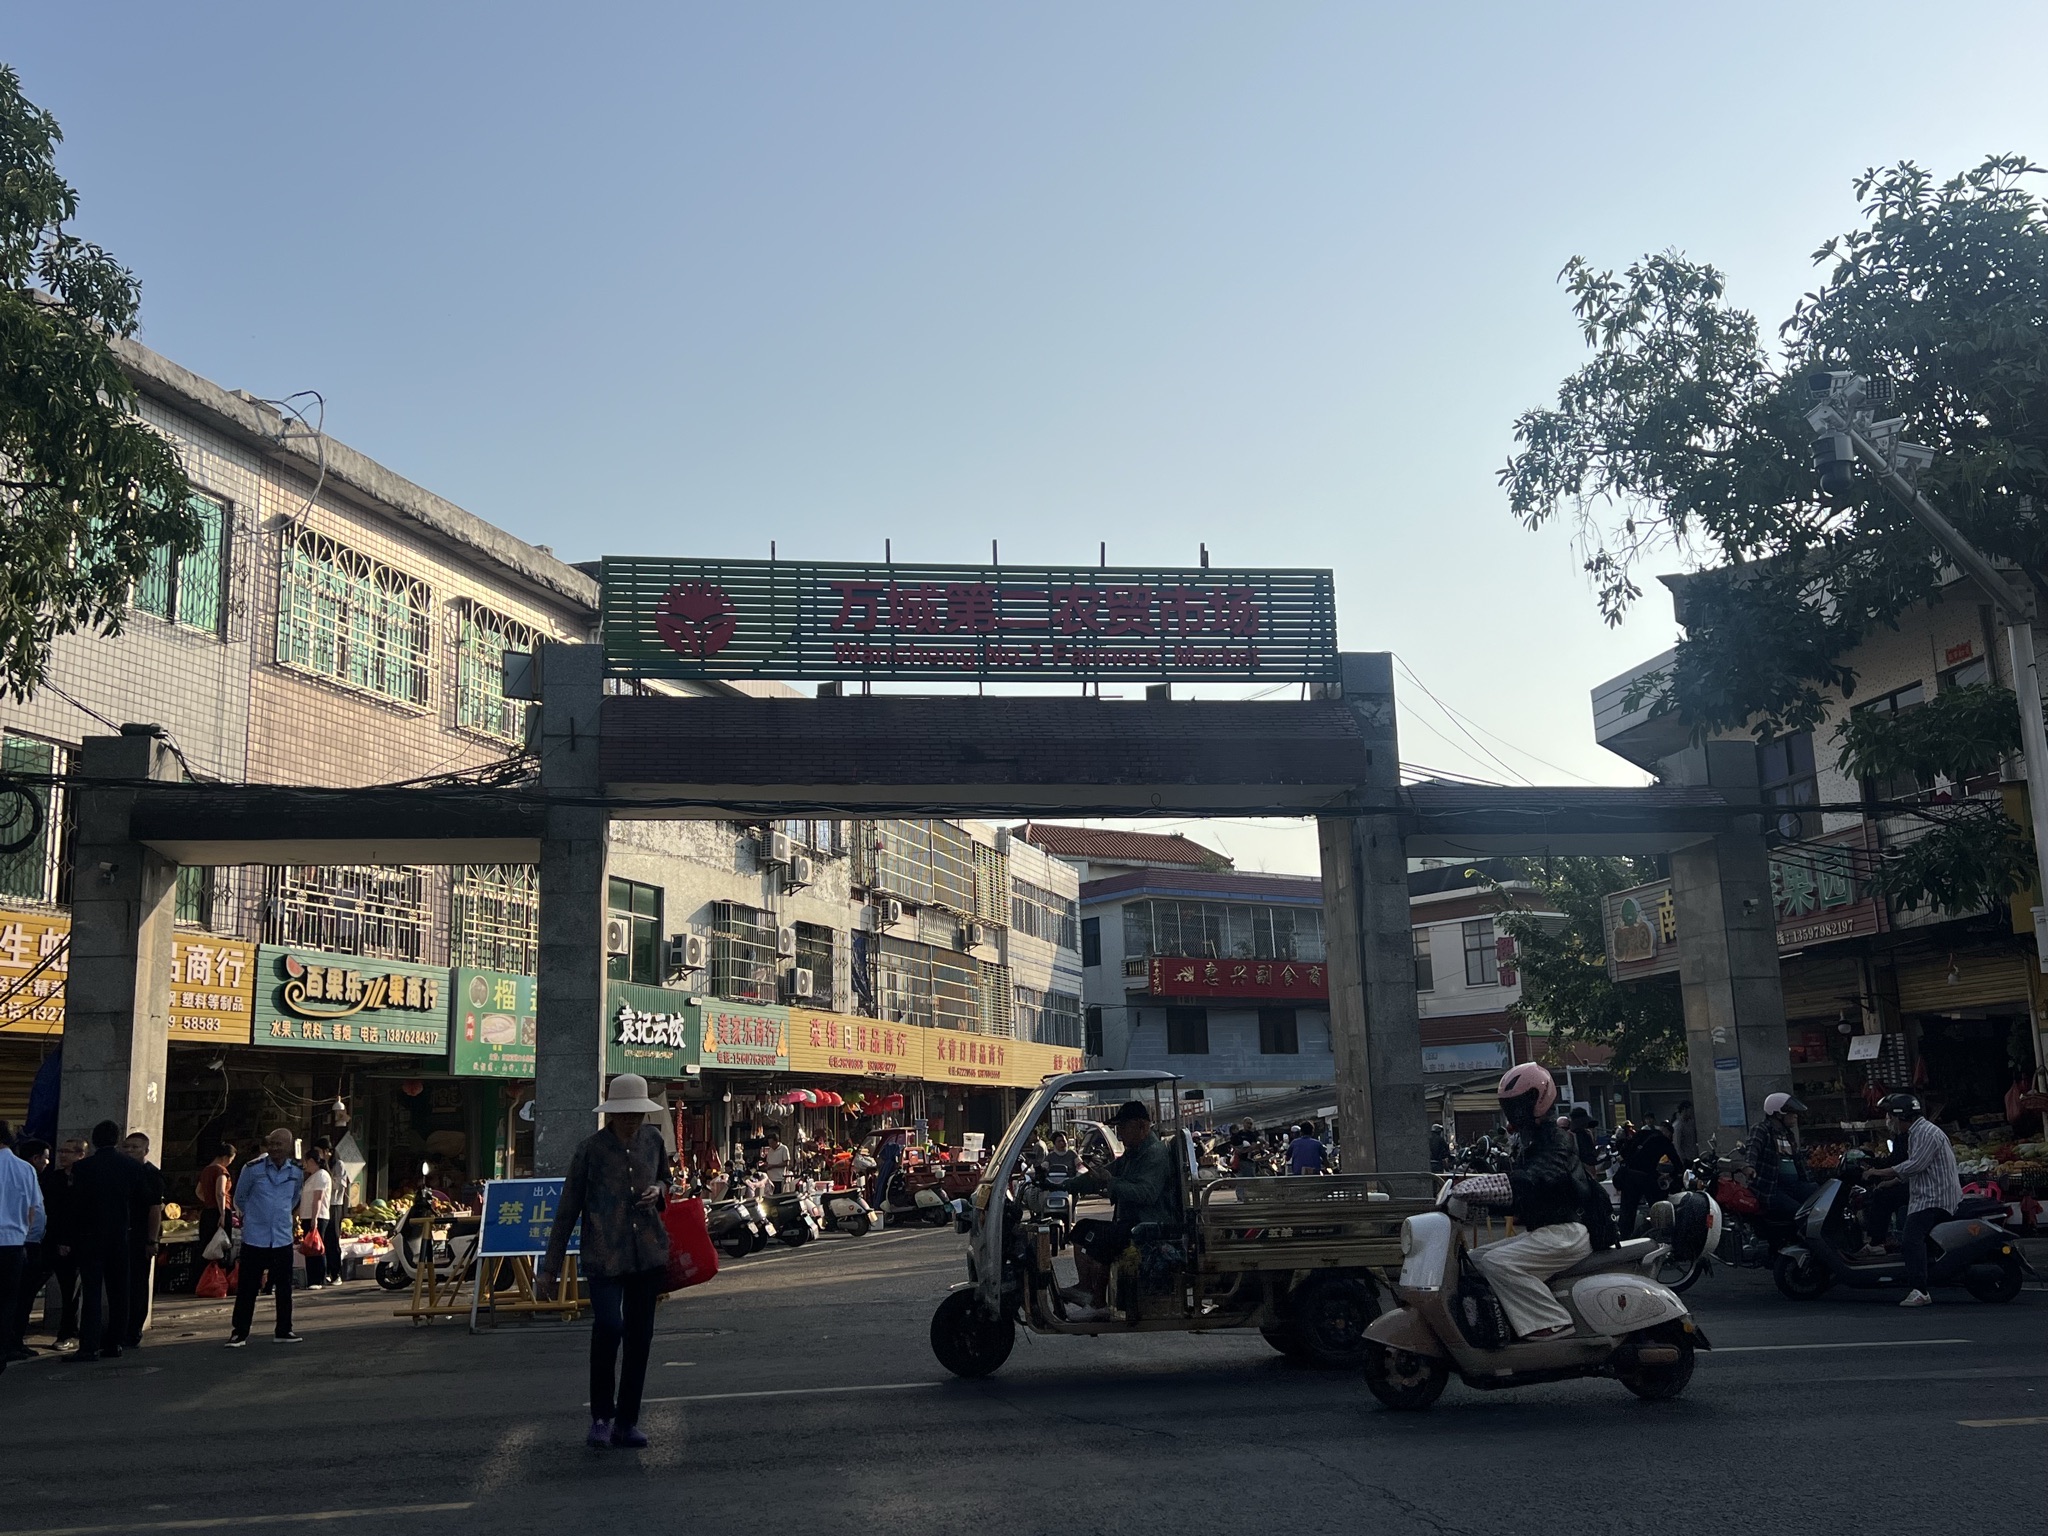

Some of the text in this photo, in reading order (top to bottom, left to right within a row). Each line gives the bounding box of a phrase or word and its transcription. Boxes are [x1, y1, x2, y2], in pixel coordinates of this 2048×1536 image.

[831, 582, 1260, 637] 万城第二农贸市场
[834, 642, 975, 670] Wancheng
[1174, 646, 1260, 668] Market
[182, 992, 243, 1012] 塑料等制品
[183, 1016, 221, 1031] 58583
[619, 1004, 686, 1048] 袁记云饺
[717, 1013, 776, 1047] 美家乐商行
[937, 1037, 1005, 1066] 长青日用品商行
[533, 1185, 563, 1197] 出入
[498, 1200, 554, 1226] 禁止
